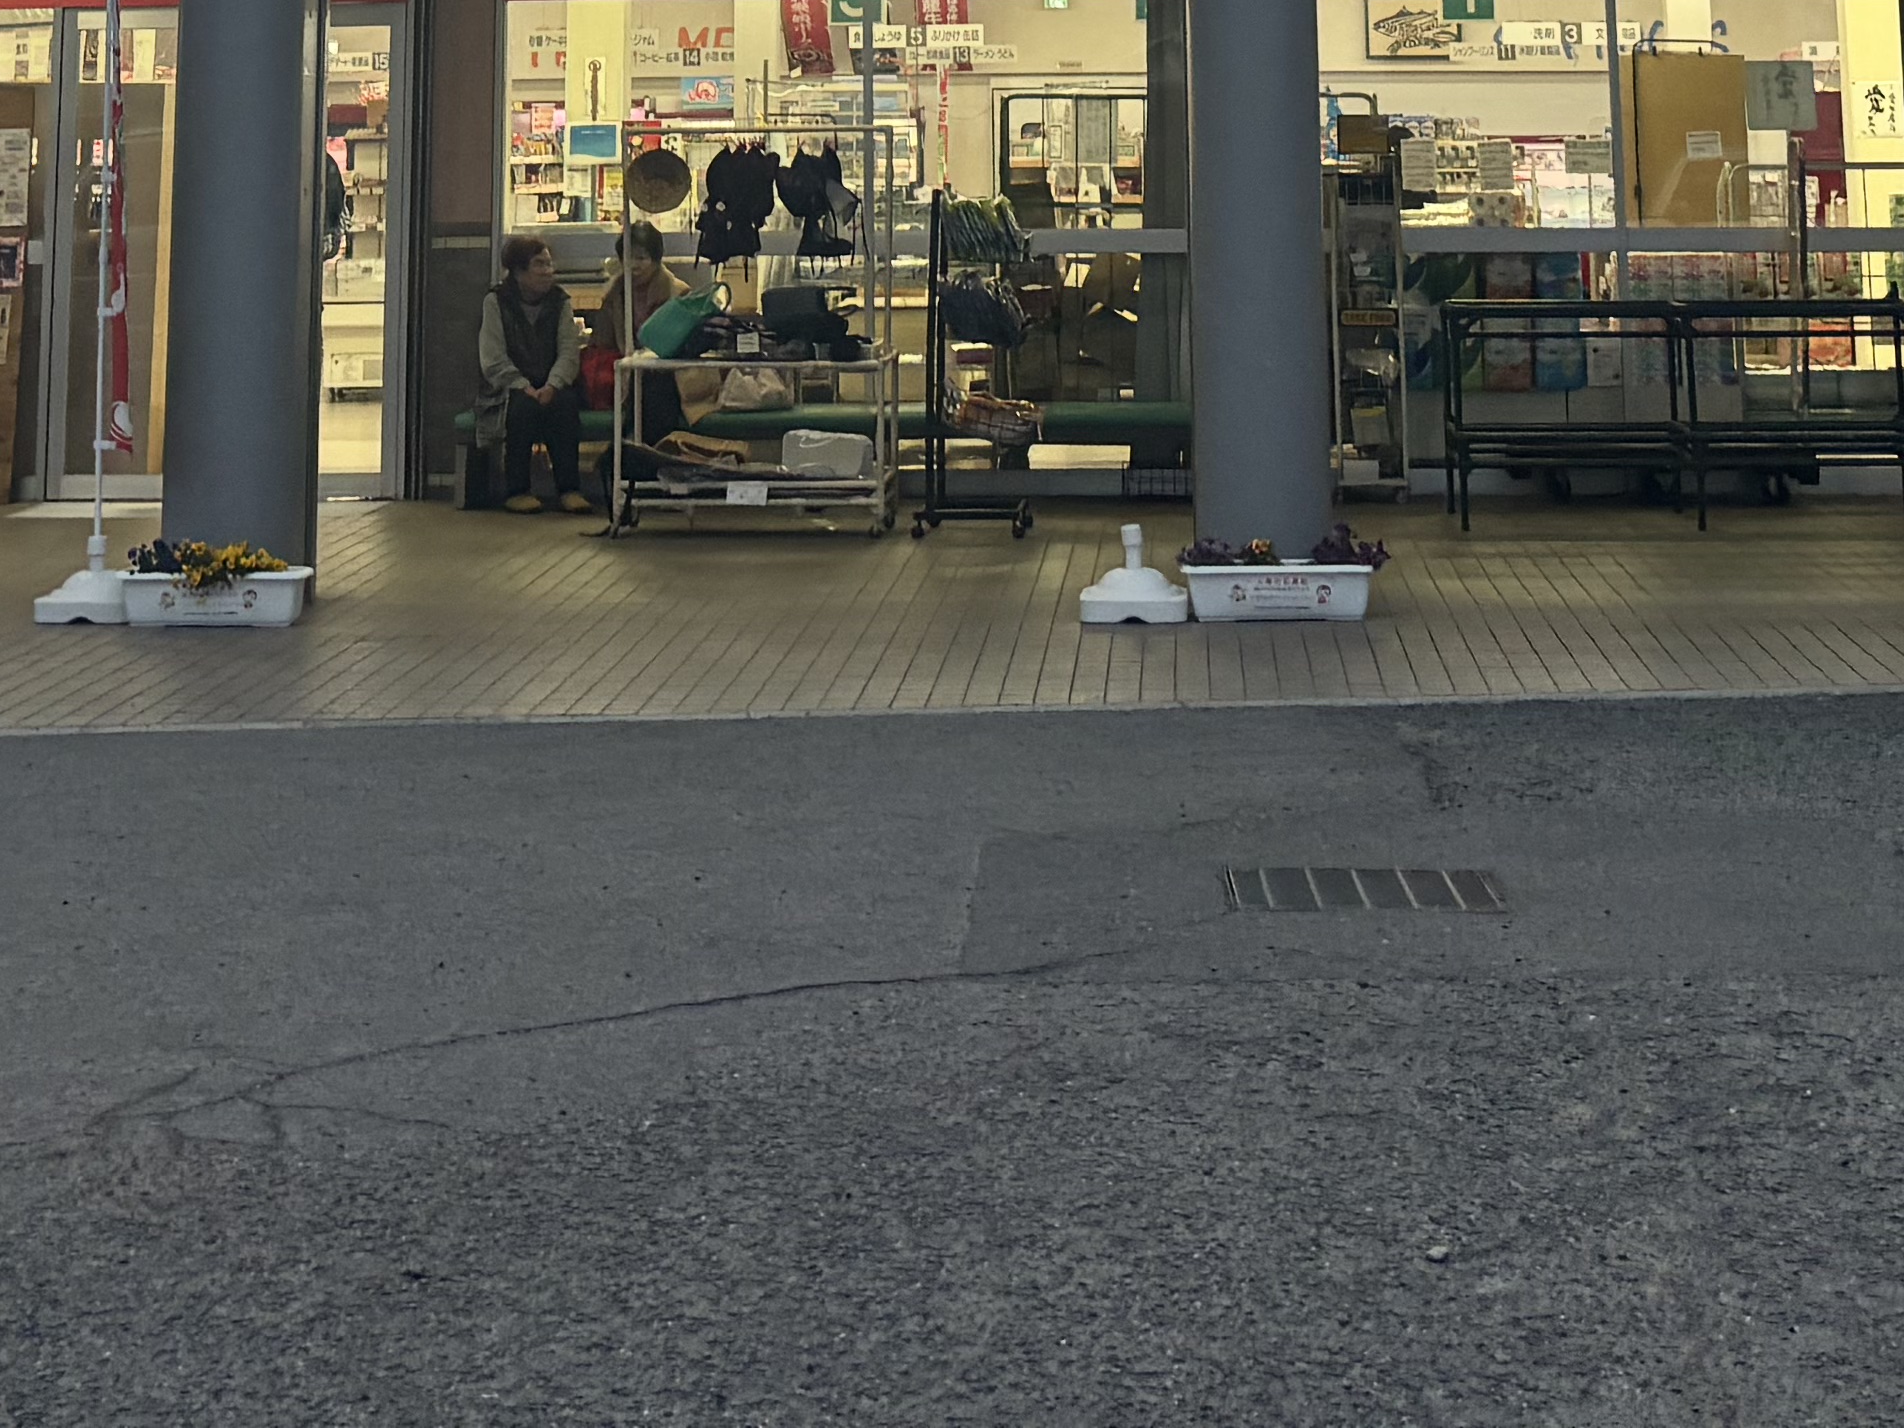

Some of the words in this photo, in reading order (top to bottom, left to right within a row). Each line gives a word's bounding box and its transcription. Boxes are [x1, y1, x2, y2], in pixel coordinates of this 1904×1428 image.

[910, 26, 923, 45] 5
[930, 29, 960, 42] ふりかけ
[1564, 24, 1578, 43] 3
[685, 49, 700, 65] 14
[956, 47, 970, 63] 13
